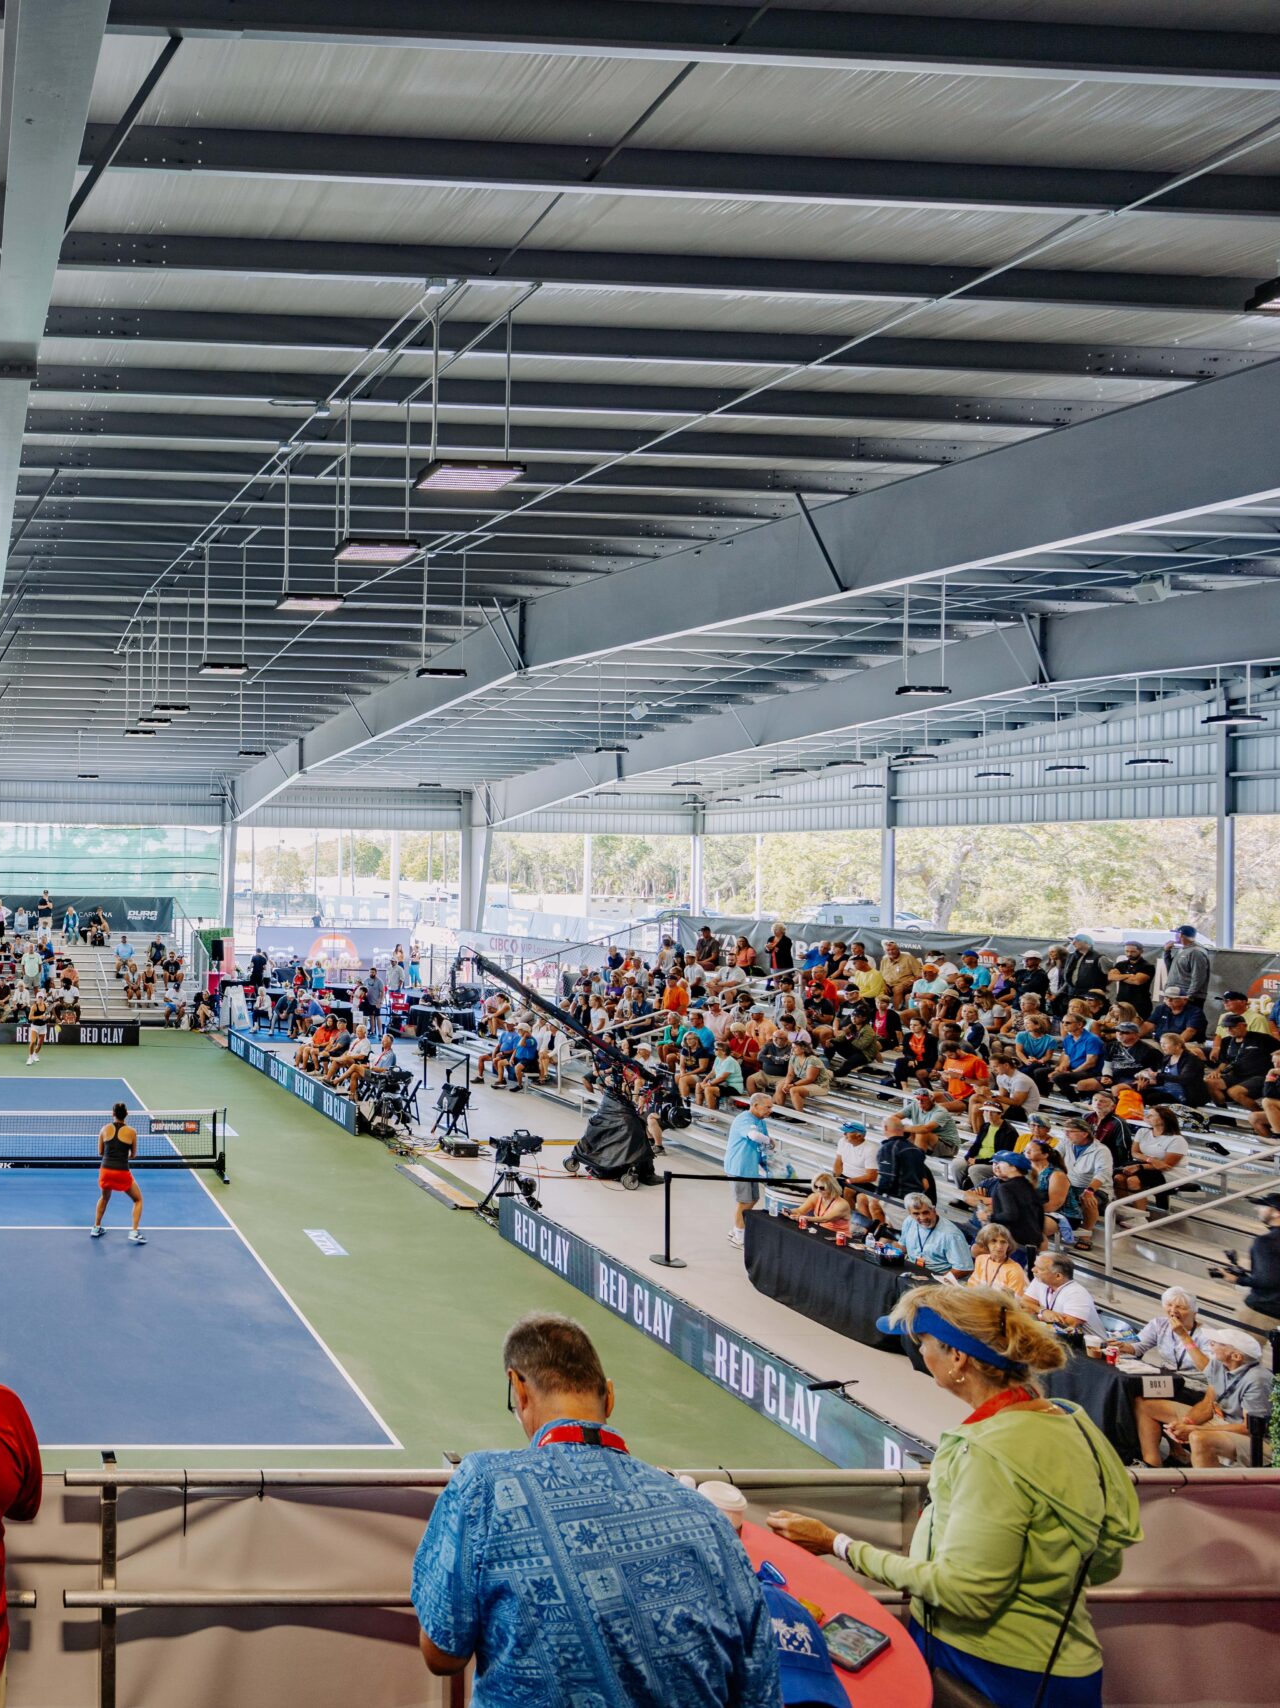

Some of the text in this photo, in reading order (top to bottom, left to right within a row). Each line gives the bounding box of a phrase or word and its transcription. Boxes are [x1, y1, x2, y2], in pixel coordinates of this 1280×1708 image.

[489, 937, 510, 951] CIBC
[521, 943, 532, 952] VIP
[80, 1027, 123, 1043] RED CLAY
[270, 1058, 278, 1080] RED
[294, 1073, 314, 1104] RED CLAY
[323, 1091, 346, 1126] RED CLAY
[151, 1122, 184, 1132] guaranteed
[514, 1209, 570, 1275] RED CLAY
[599, 1261, 673, 1345] RED CLAY
[714, 1333, 821, 1443] RED CLAY
[1149, 1381, 1162, 1389] BOX
